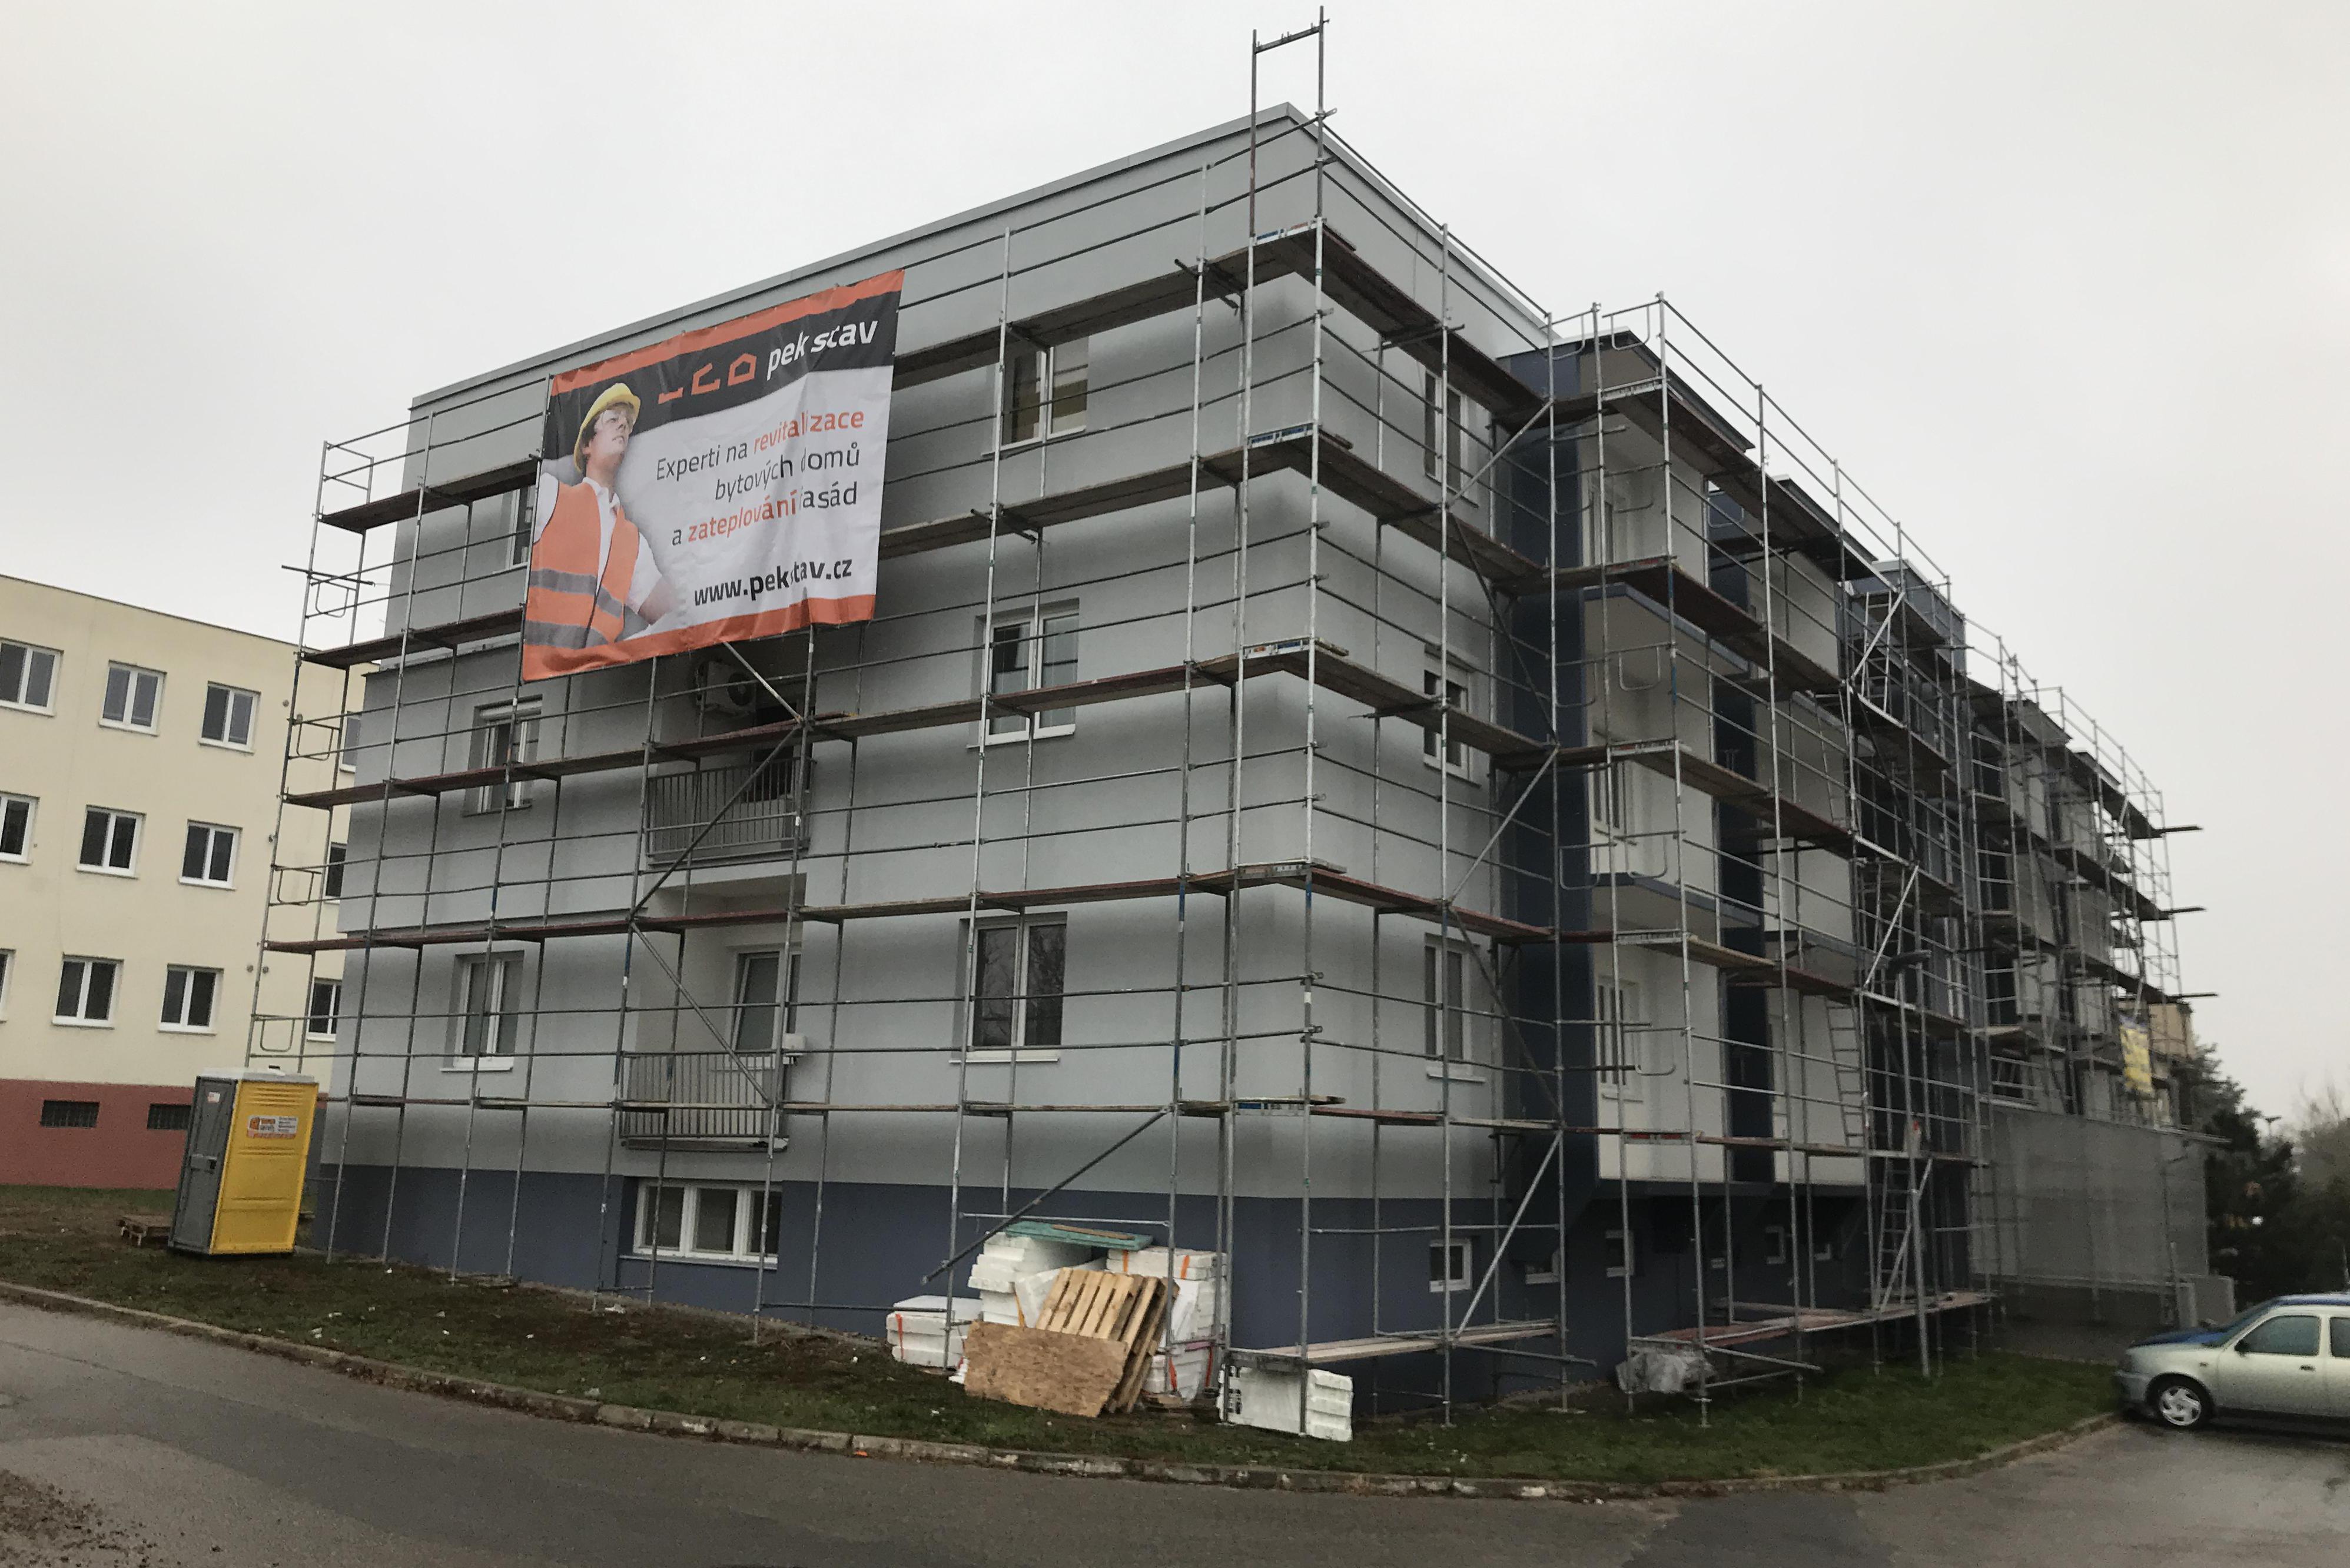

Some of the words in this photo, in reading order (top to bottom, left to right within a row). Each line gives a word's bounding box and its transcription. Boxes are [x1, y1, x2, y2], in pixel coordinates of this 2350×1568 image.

[656, 444, 721, 481] Experti
[726, 442, 748, 463] na
[754, 410, 864, 454] revitalizace
[715, 454, 793, 503] bytových
[801, 441, 859, 473] domů
[672, 529, 682, 546] a
[688, 490, 797, 543] zateplování
[694, 559, 852, 606] www.pekstav.cz
